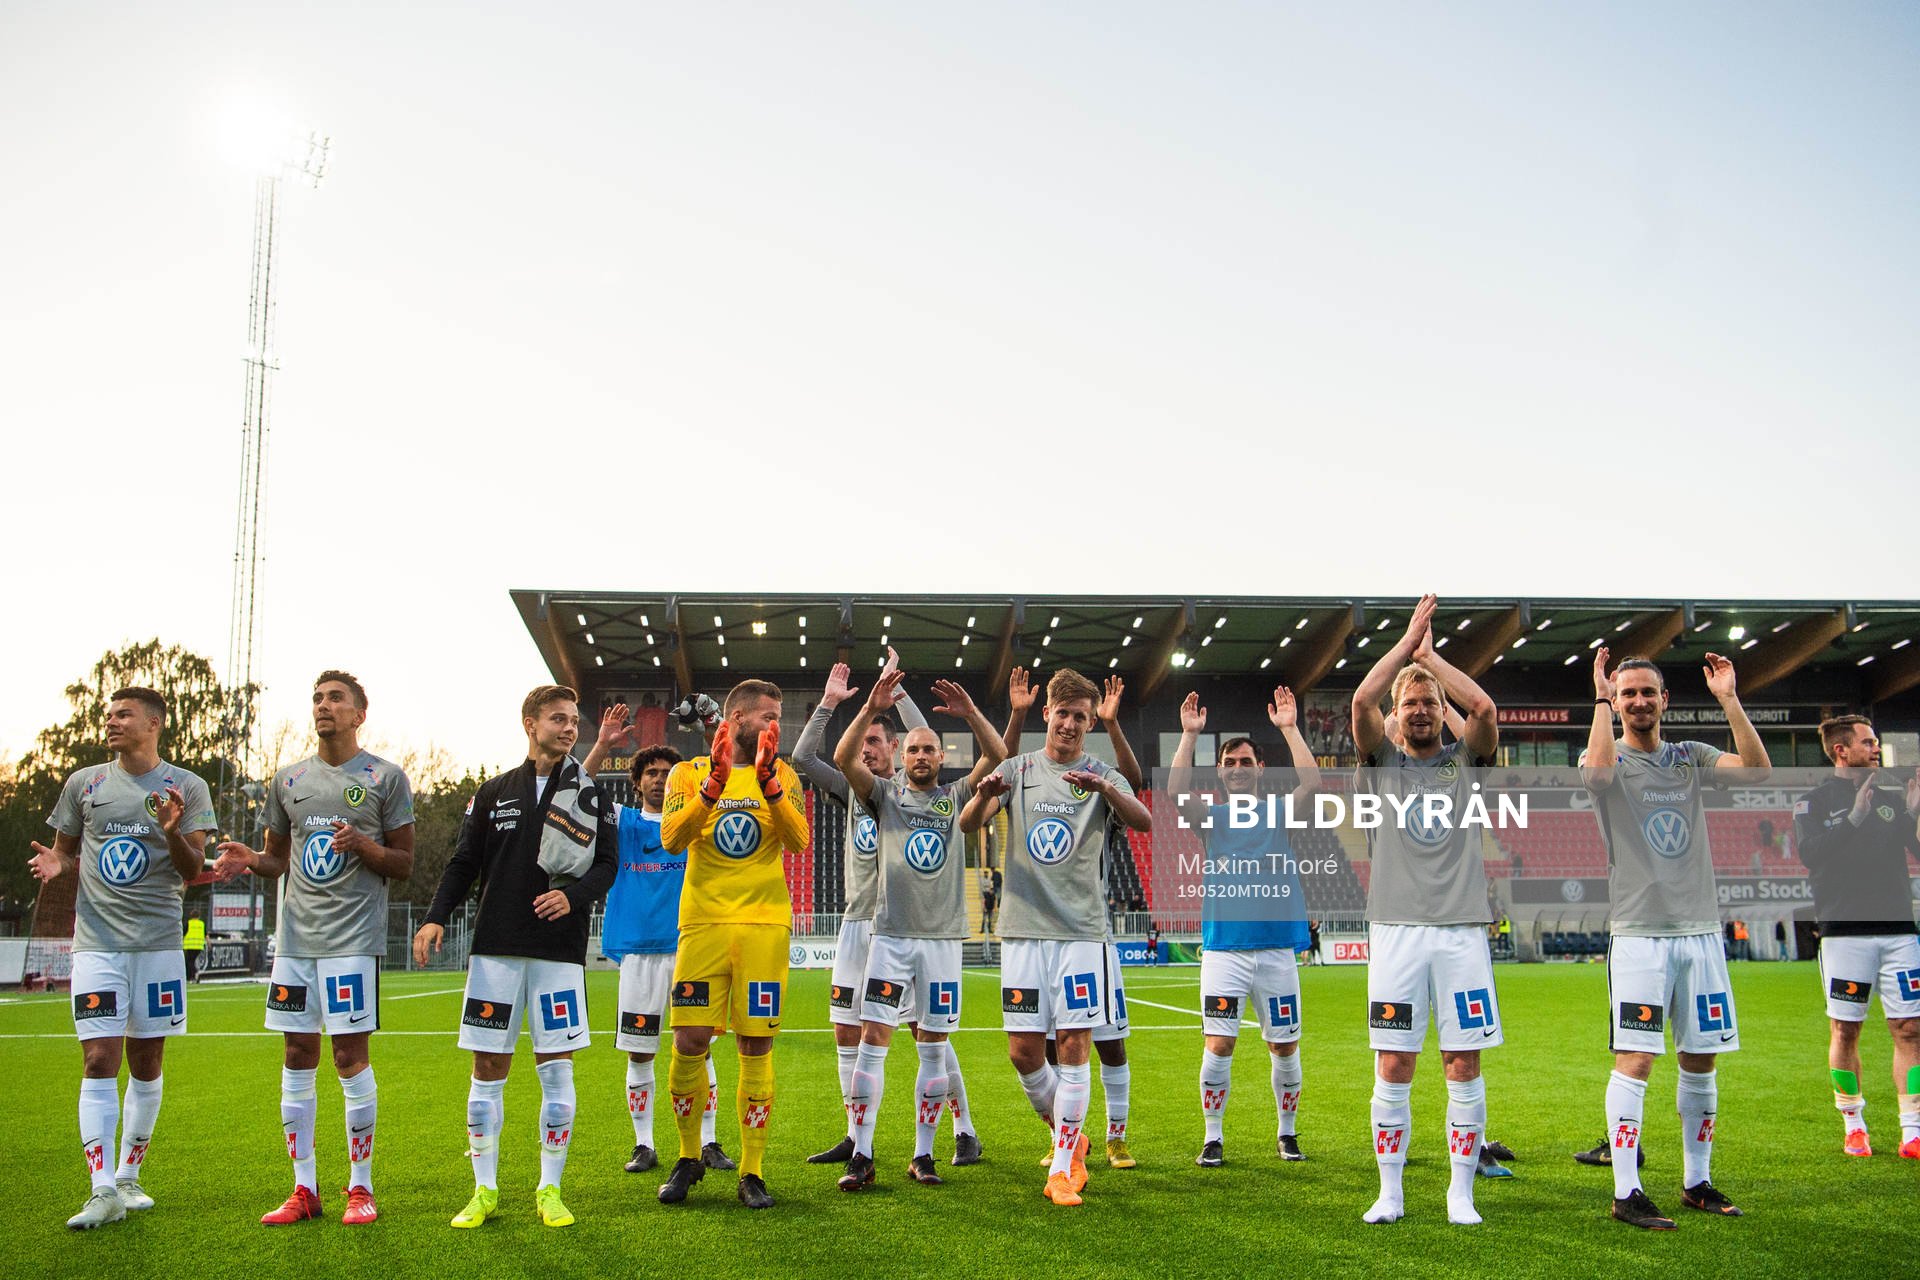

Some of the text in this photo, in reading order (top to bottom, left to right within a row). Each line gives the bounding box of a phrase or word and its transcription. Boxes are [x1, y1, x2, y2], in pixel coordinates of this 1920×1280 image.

[1499, 710, 1569, 722] BAUHAUS
[1662, 710, 1696, 722] VENSK
[1642, 791, 1687, 802] Atteviks
[717, 798, 760, 810] Atteviks
[1032, 802, 1075, 814] Atteviks
[105, 822, 150, 834] Atteviks
[909, 816, 948, 829] Atteviks
[1758, 880, 1814, 899] Stock
[214, 908, 261, 916] BAUHAS
